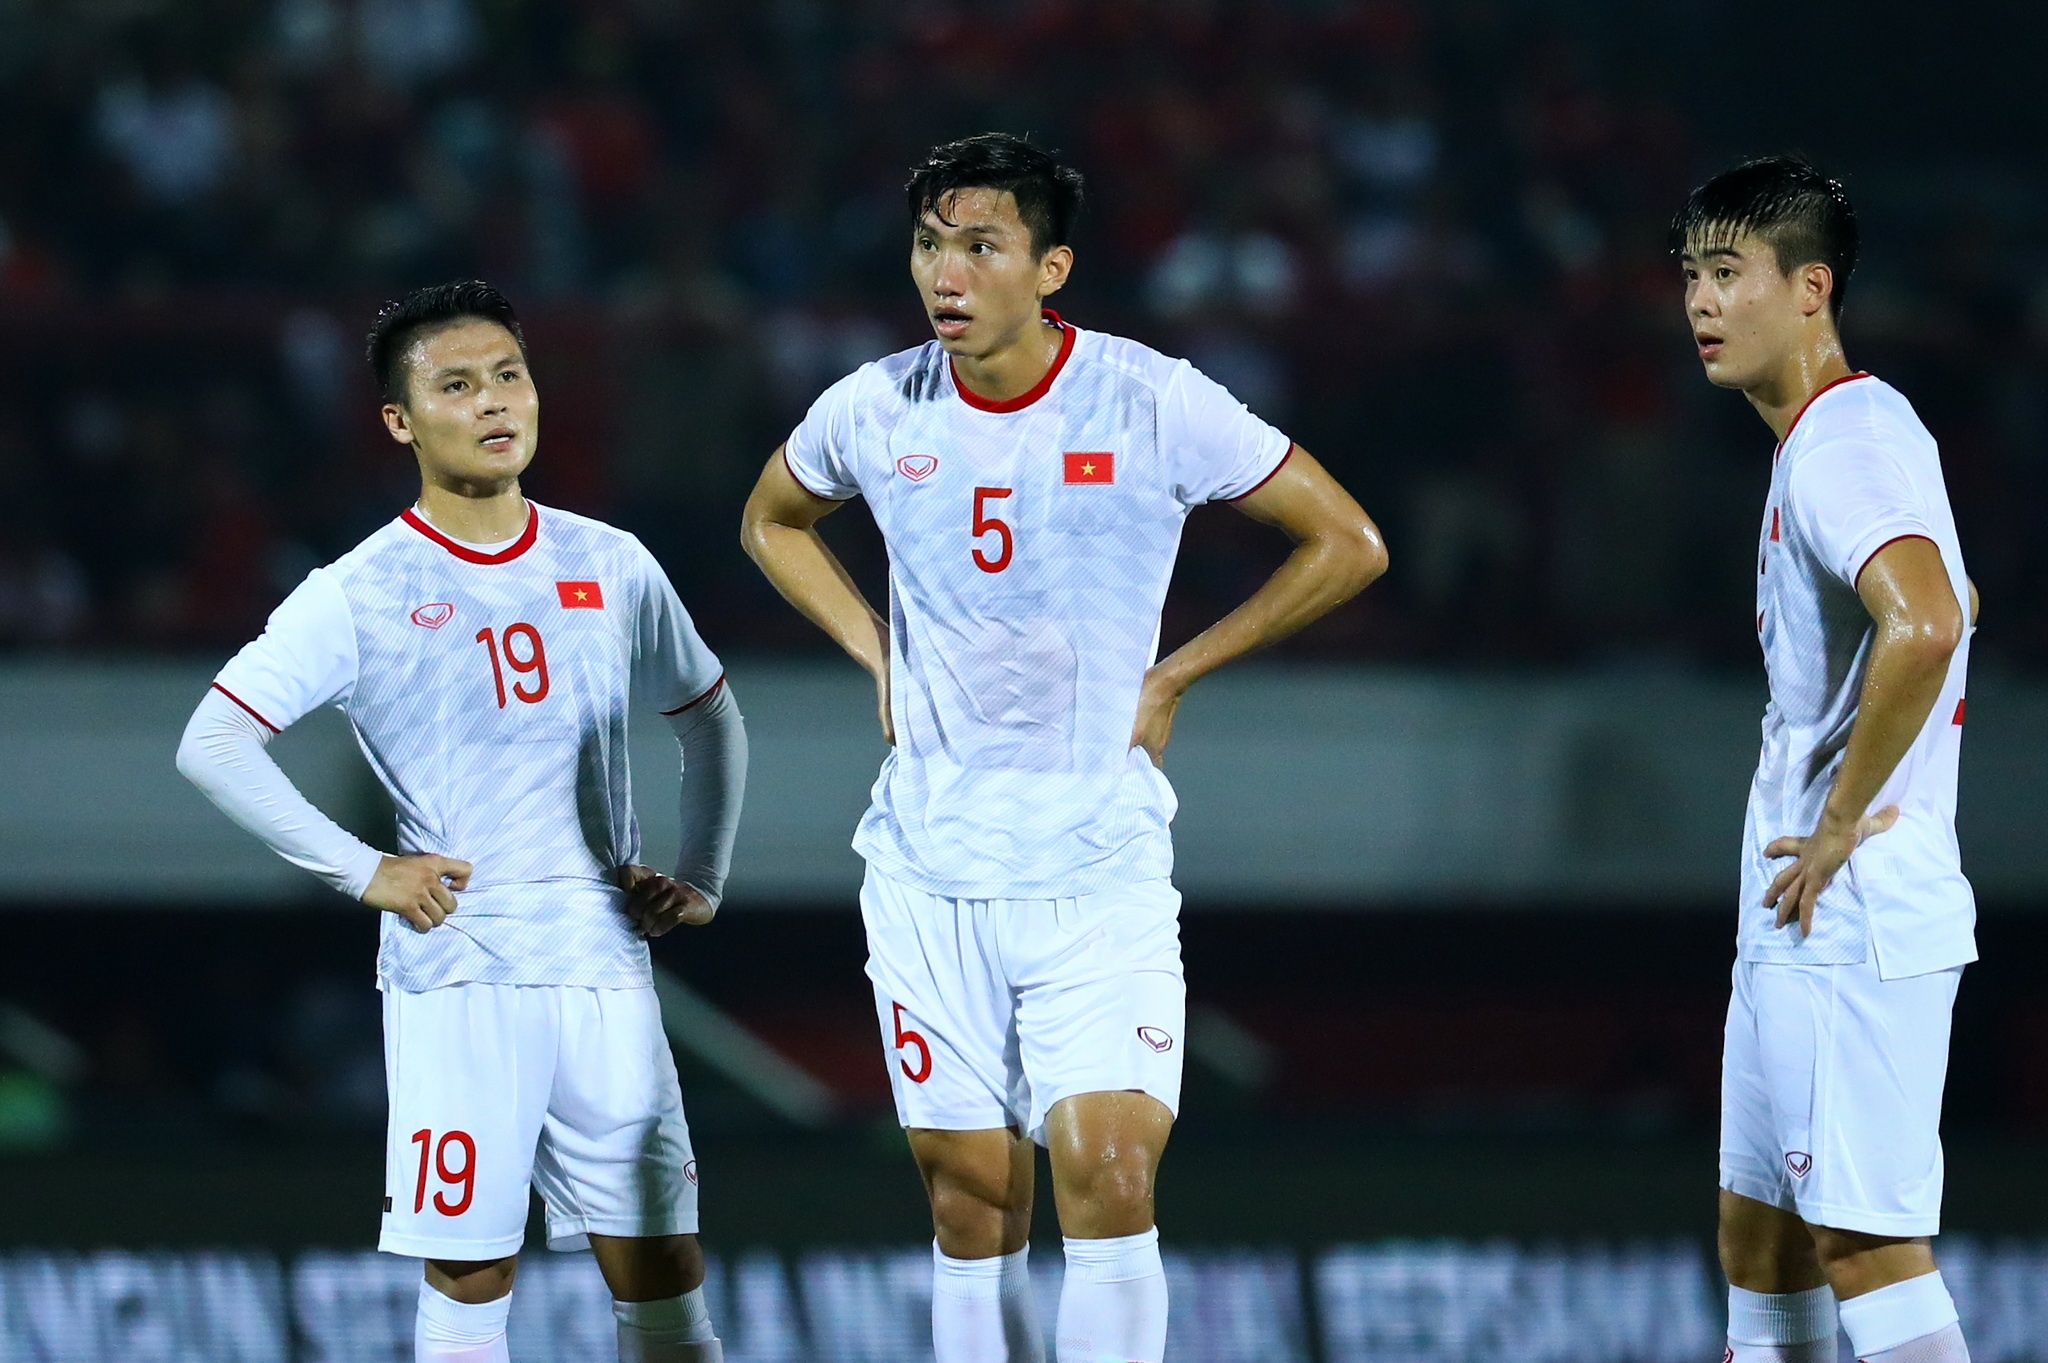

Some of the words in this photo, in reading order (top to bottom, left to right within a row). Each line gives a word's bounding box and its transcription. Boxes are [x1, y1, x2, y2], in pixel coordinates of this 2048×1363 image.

[973, 487, 1013, 574] 5
[476, 622, 549, 707] 19
[892, 1000, 932, 1084] 5
[411, 1128, 477, 1217] 19
